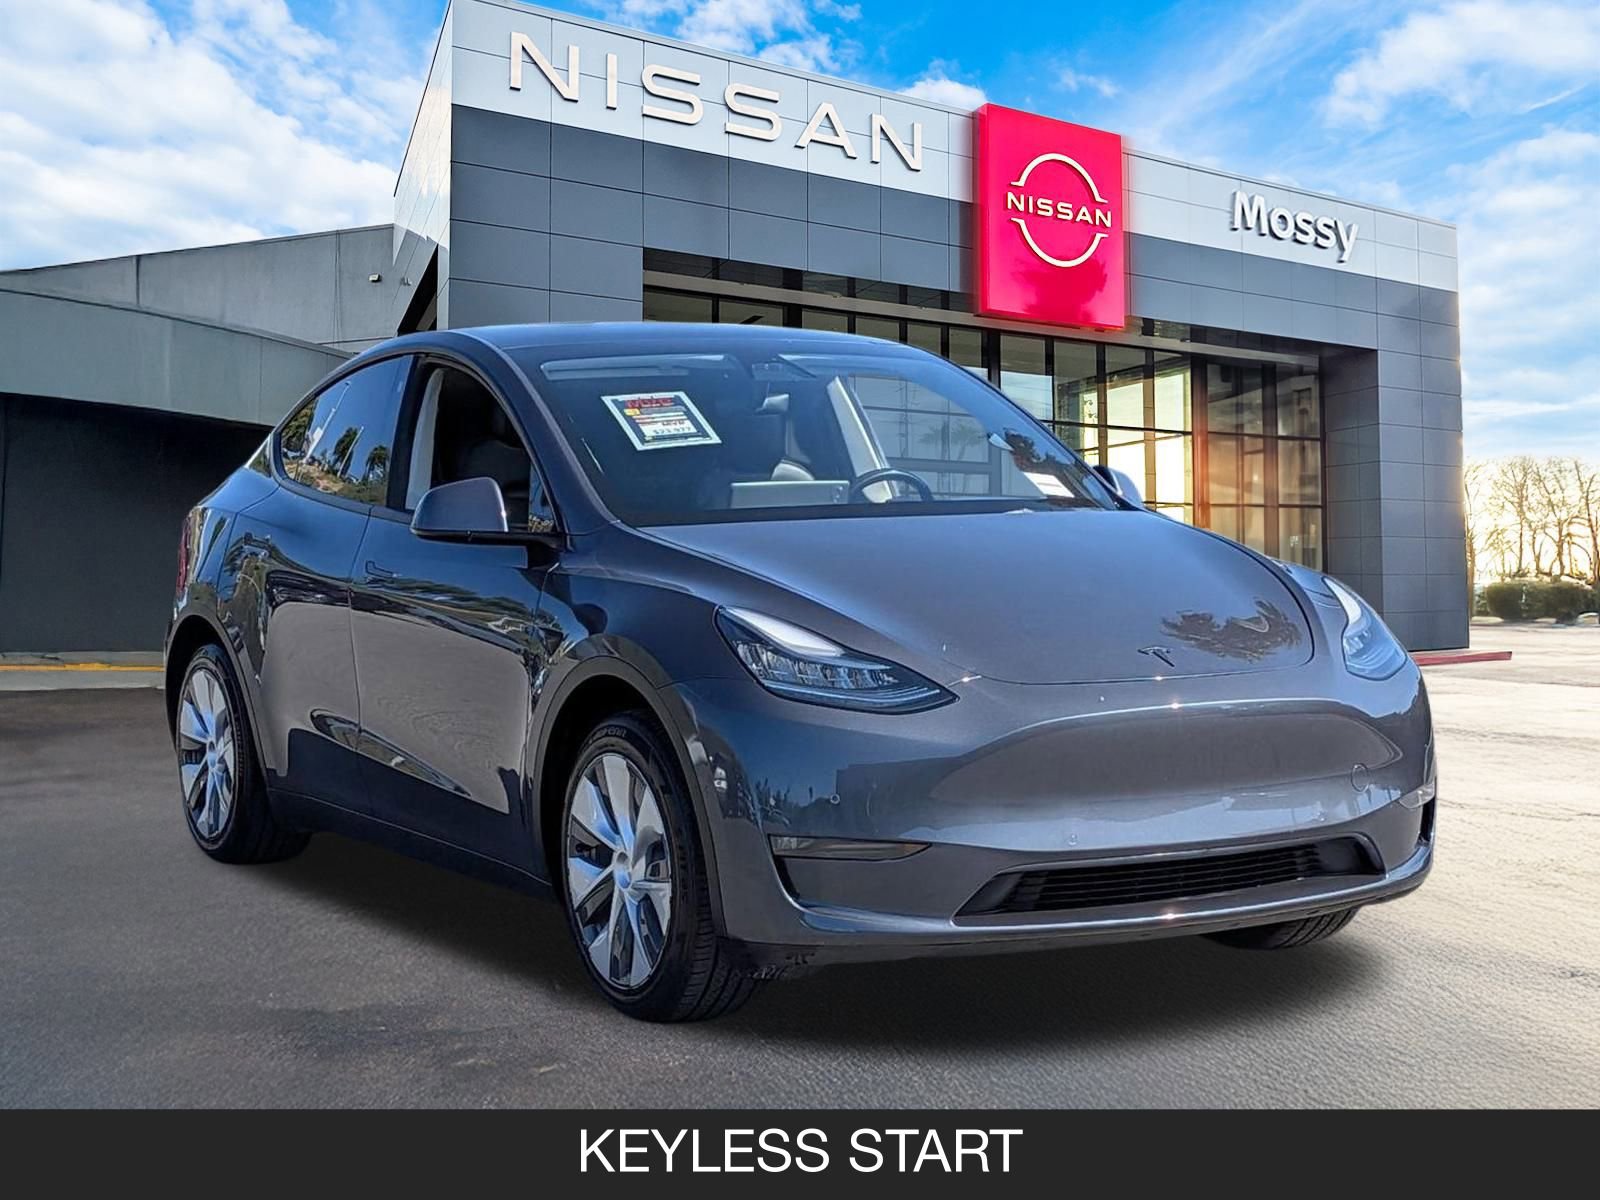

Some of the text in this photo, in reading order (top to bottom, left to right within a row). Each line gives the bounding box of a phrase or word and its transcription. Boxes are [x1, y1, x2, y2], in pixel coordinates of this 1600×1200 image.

[509, 31, 923, 172] NISSAN
[1006, 191, 1113, 229] NISSAN
[1231, 190, 1359, 263] Mossy
